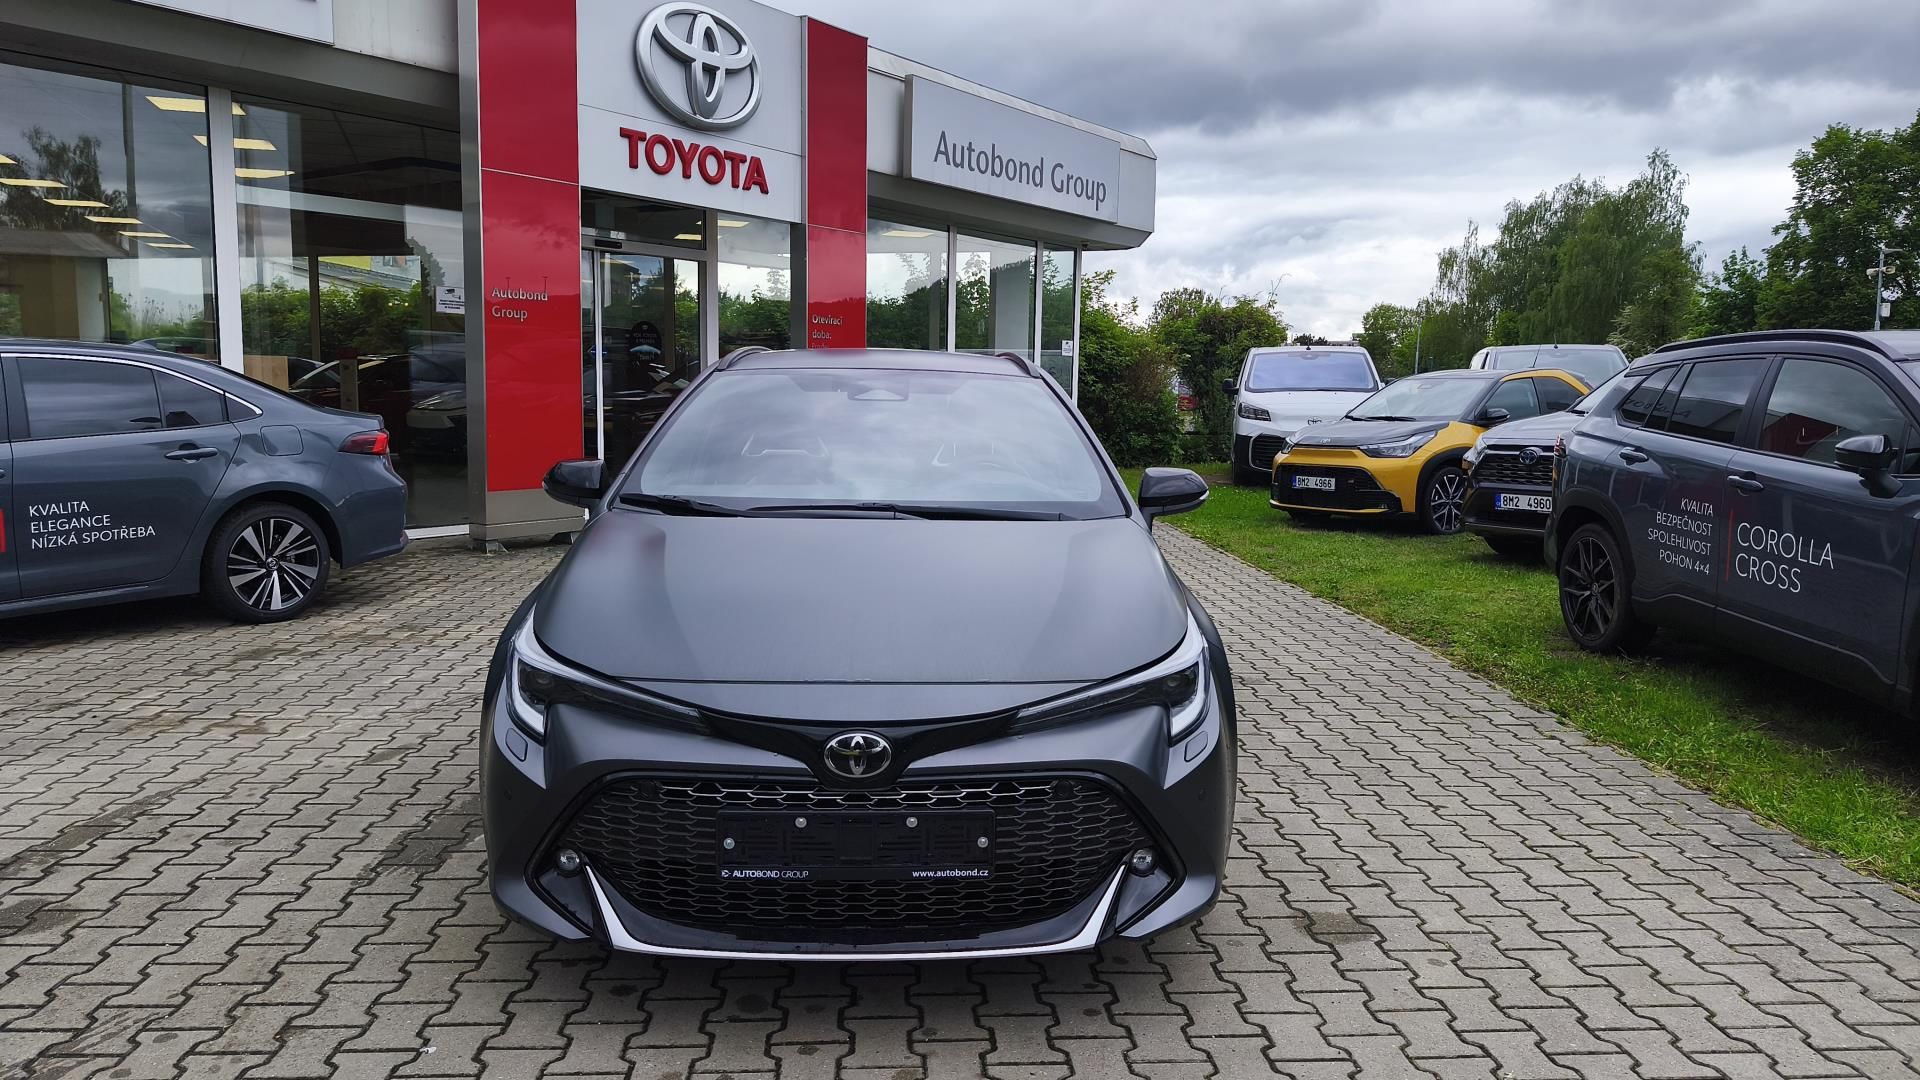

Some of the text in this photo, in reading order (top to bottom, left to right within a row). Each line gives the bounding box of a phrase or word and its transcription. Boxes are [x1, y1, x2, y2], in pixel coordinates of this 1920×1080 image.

[619, 126, 770, 195] TOYOTA
[933, 130, 1107, 211] Autobond Group
[491, 287, 548, 301] Autobond
[491, 305, 528, 322] Group
[29, 500, 90, 518] KVALITA
[1502, 495, 1551, 510] 8M2 4960
[1680, 498, 1714, 517] KVALITA
[30, 514, 112, 534] ELEGANCE
[1656, 511, 1713, 537] BEZPEČNOST
[31, 525, 156, 550] NÍZKÁ SPOTŘEBA
[1647, 528, 1712, 556] SPOLEHLIVOST
[1737, 522, 1834, 570] COROLLA
[1659, 549, 1693, 570] POHON
[1735, 553, 1801, 593] CROSS
[732, 870, 809, 879] AUTOBOND GROUP
[912, 868, 989, 878] www.autobond.cz
